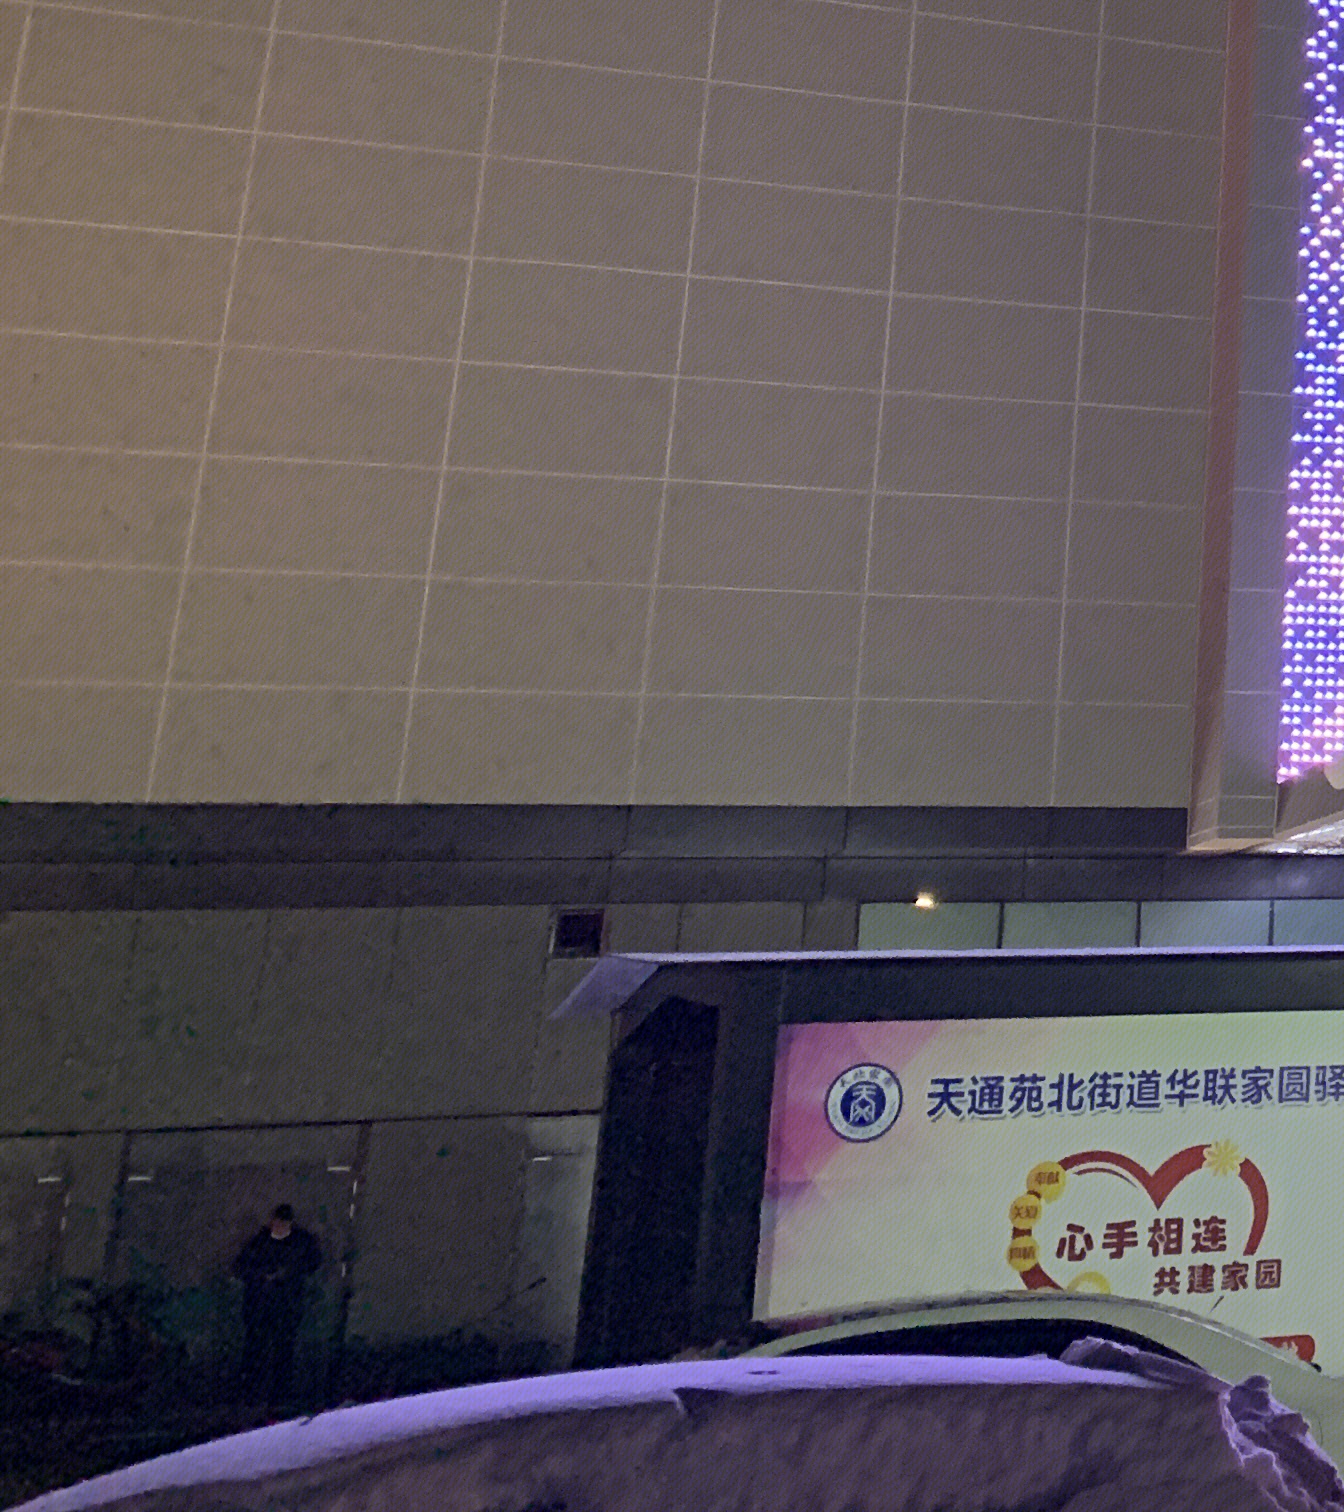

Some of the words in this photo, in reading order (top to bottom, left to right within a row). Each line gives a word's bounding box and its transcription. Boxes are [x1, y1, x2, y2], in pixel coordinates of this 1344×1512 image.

[1056, 1215, 1227, 1261] 心手相连
[1153, 1259, 1282, 1296] 共建家园
